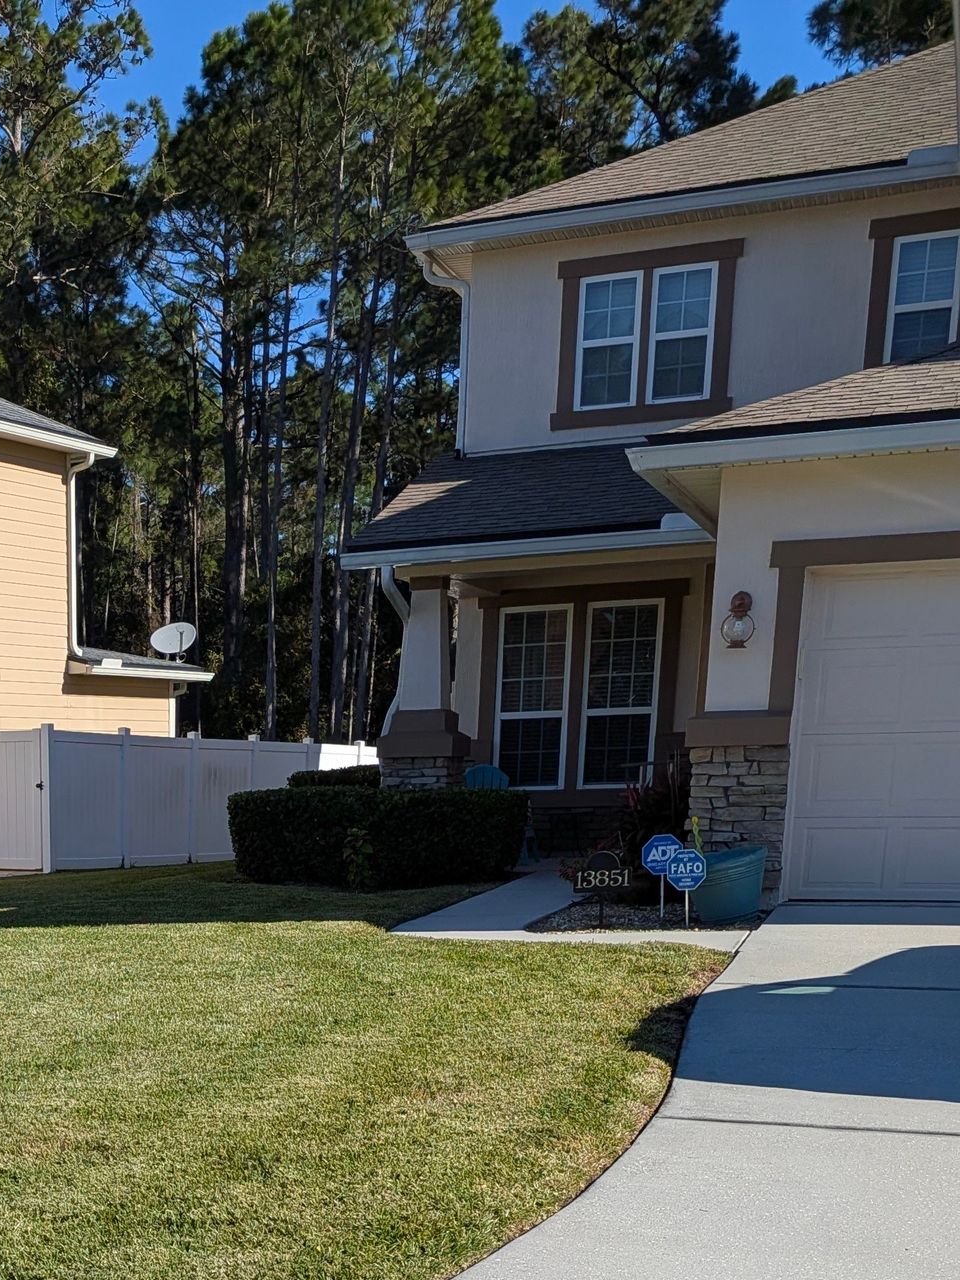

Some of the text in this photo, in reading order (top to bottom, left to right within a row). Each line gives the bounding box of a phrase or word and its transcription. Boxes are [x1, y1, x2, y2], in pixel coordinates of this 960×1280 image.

[646, 844, 679, 862] ADT
[671, 862, 703, 874] FAFO
[575, 869, 630, 889] 13851
